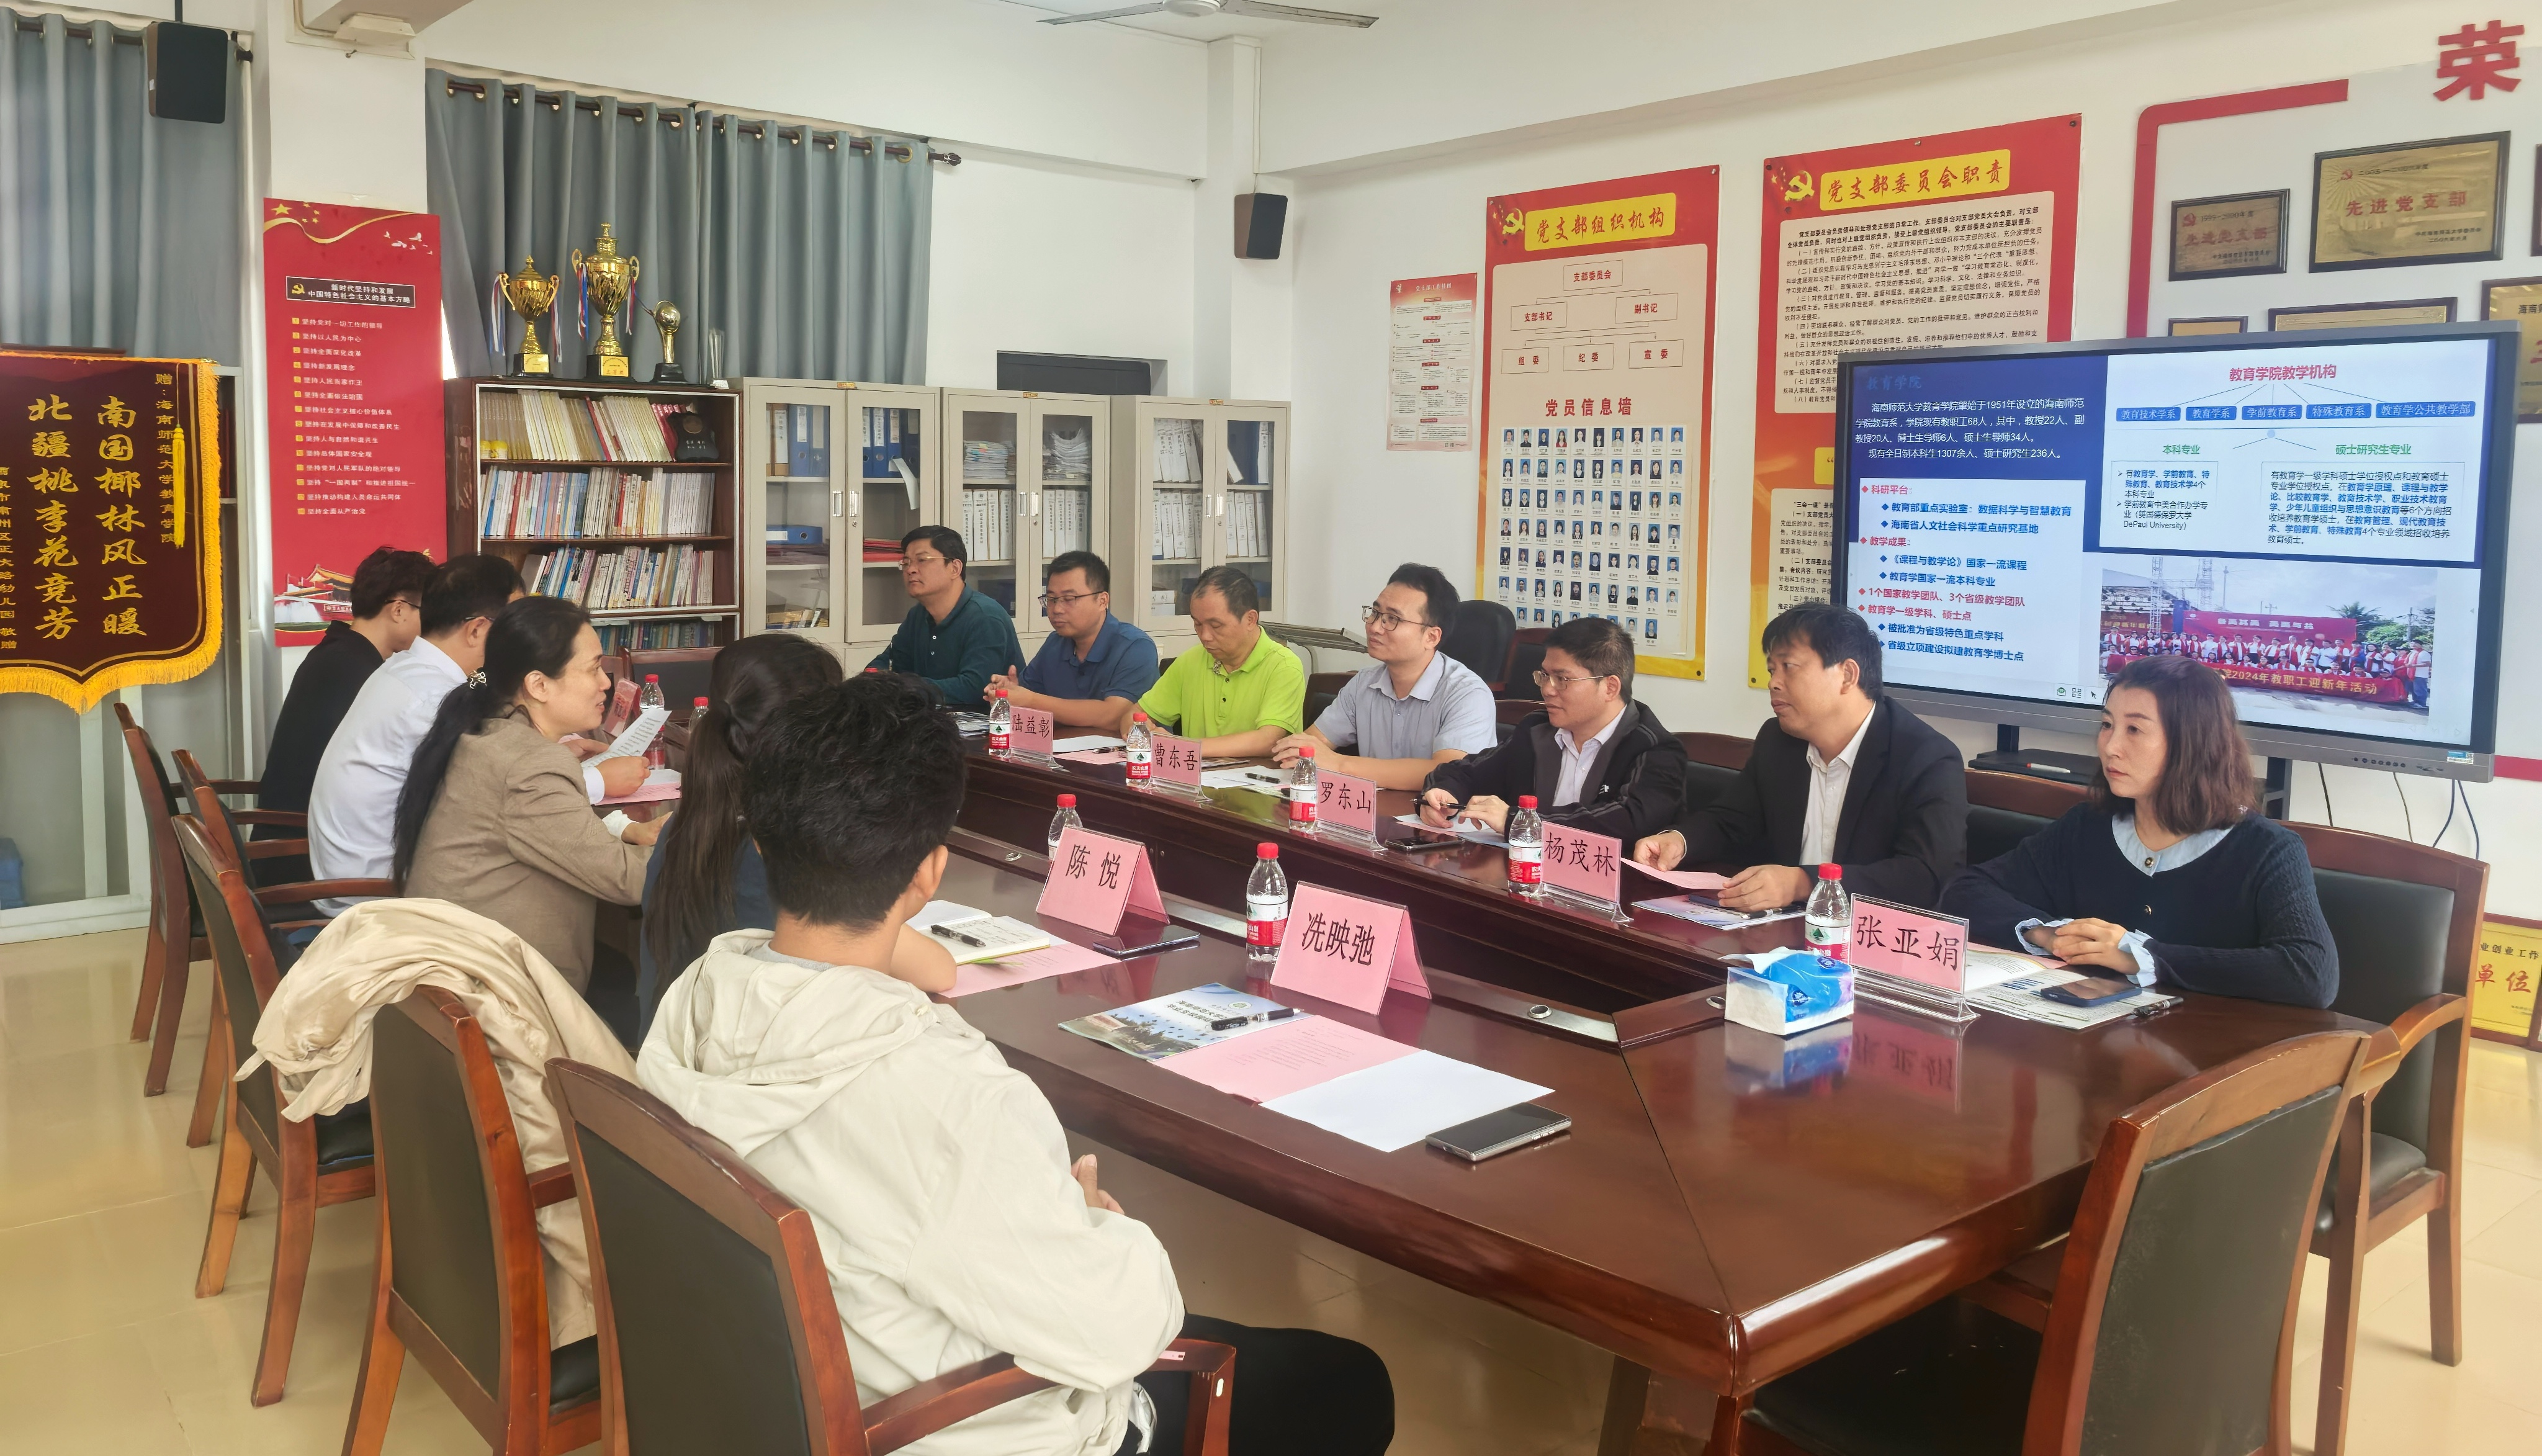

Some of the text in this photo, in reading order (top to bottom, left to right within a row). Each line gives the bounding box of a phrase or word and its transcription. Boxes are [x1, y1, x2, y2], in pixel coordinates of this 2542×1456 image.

[2433, 19, 2525, 101] 荣
[1828, 159, 2003, 203] 党支部委员会职责
[2346, 190, 2467, 217] 先进党支部
[1536, 207, 1664, 243] 党支部组织机构
[1573, 269, 1612, 282] 支部委员会
[331, 284, 394, 295] 新时代坚持和发展
[308, 290, 410, 303] 中国特色社会主义的基本方略
[1633, 303, 1658, 314] 副书记
[1524, 311, 1553, 322] 支部书记
[302, 318, 382, 330] 坚持党对一切工作的领导
[302, 333, 362, 343] 坚持以人民为中心
[303, 347, 361, 357] 坚持全面深化改革
[303, 362, 356, 371] 坚持新发展理念
[2229, 364, 2337, 382] 教育学院教学机构
[303, 377, 362, 386] 坚持人民当家作主
[1867, 375, 1922, 390] 教育学院
[304, 391, 363, 400] 坚持全面依法治国
[305, 406, 392, 415] 坚持社会主义核心价值体系
[1545, 397, 1632, 417] 党员信息墙
[1871, 398, 2085, 412] 海南师范大学教育学院肇始于1951年设立的海南师范
[2312, 405, 2365, 417] 特殊教育系
[2381, 403, 2471, 415] 教育学公共教学部
[2121, 408, 2176, 419] 教育技术学系
[2192, 408, 2230, 418] 教育学系
[2247, 407, 2297, 418] 学前教育系
[305, 420, 400, 430] 坚持在发展中保障和改善民生
[305, 435, 379, 444] 坚持人与自然和谐共生
[2163, 444, 2201, 454] 本科专业
[2335, 444, 2412, 455] 硕士研究生专业
[2125, 490, 2155, 498] 本科专业
[2124, 500, 2208, 510] 学前教育中美合作办学专
[26, 393, 79, 640] 北疆桃李花竞芳
[94, 395, 147, 636] 南国椰林风正暖
[1891, 520, 2039, 534] 海南省人文社会科学重点研究基地
[1893, 554, 2027, 570] 《课程与教学论》国家一流课程
[1889, 572, 1996, 587] 教育学国家一流本科专业
[1869, 587, 2026, 607] 1个国家教学团队、3个省级教学团队
[1868, 604, 1972, 621] 教育学一级学科、硕士点
[1888, 623, 2004, 642] 被批准为省级特色重点学科
[1887, 640, 2024, 661] 省级立项建设拟建教育学博士点
[1012, 713, 1050, 739] 陆益彰
[1153, 743, 1198, 771] 曹东吾
[1321, 781, 1372, 814] 罗东山
[1544, 832, 1617, 877] 杨茂林
[1856, 915, 1960, 971] 张亚娟
[2475, 963, 2531, 993] 单位
